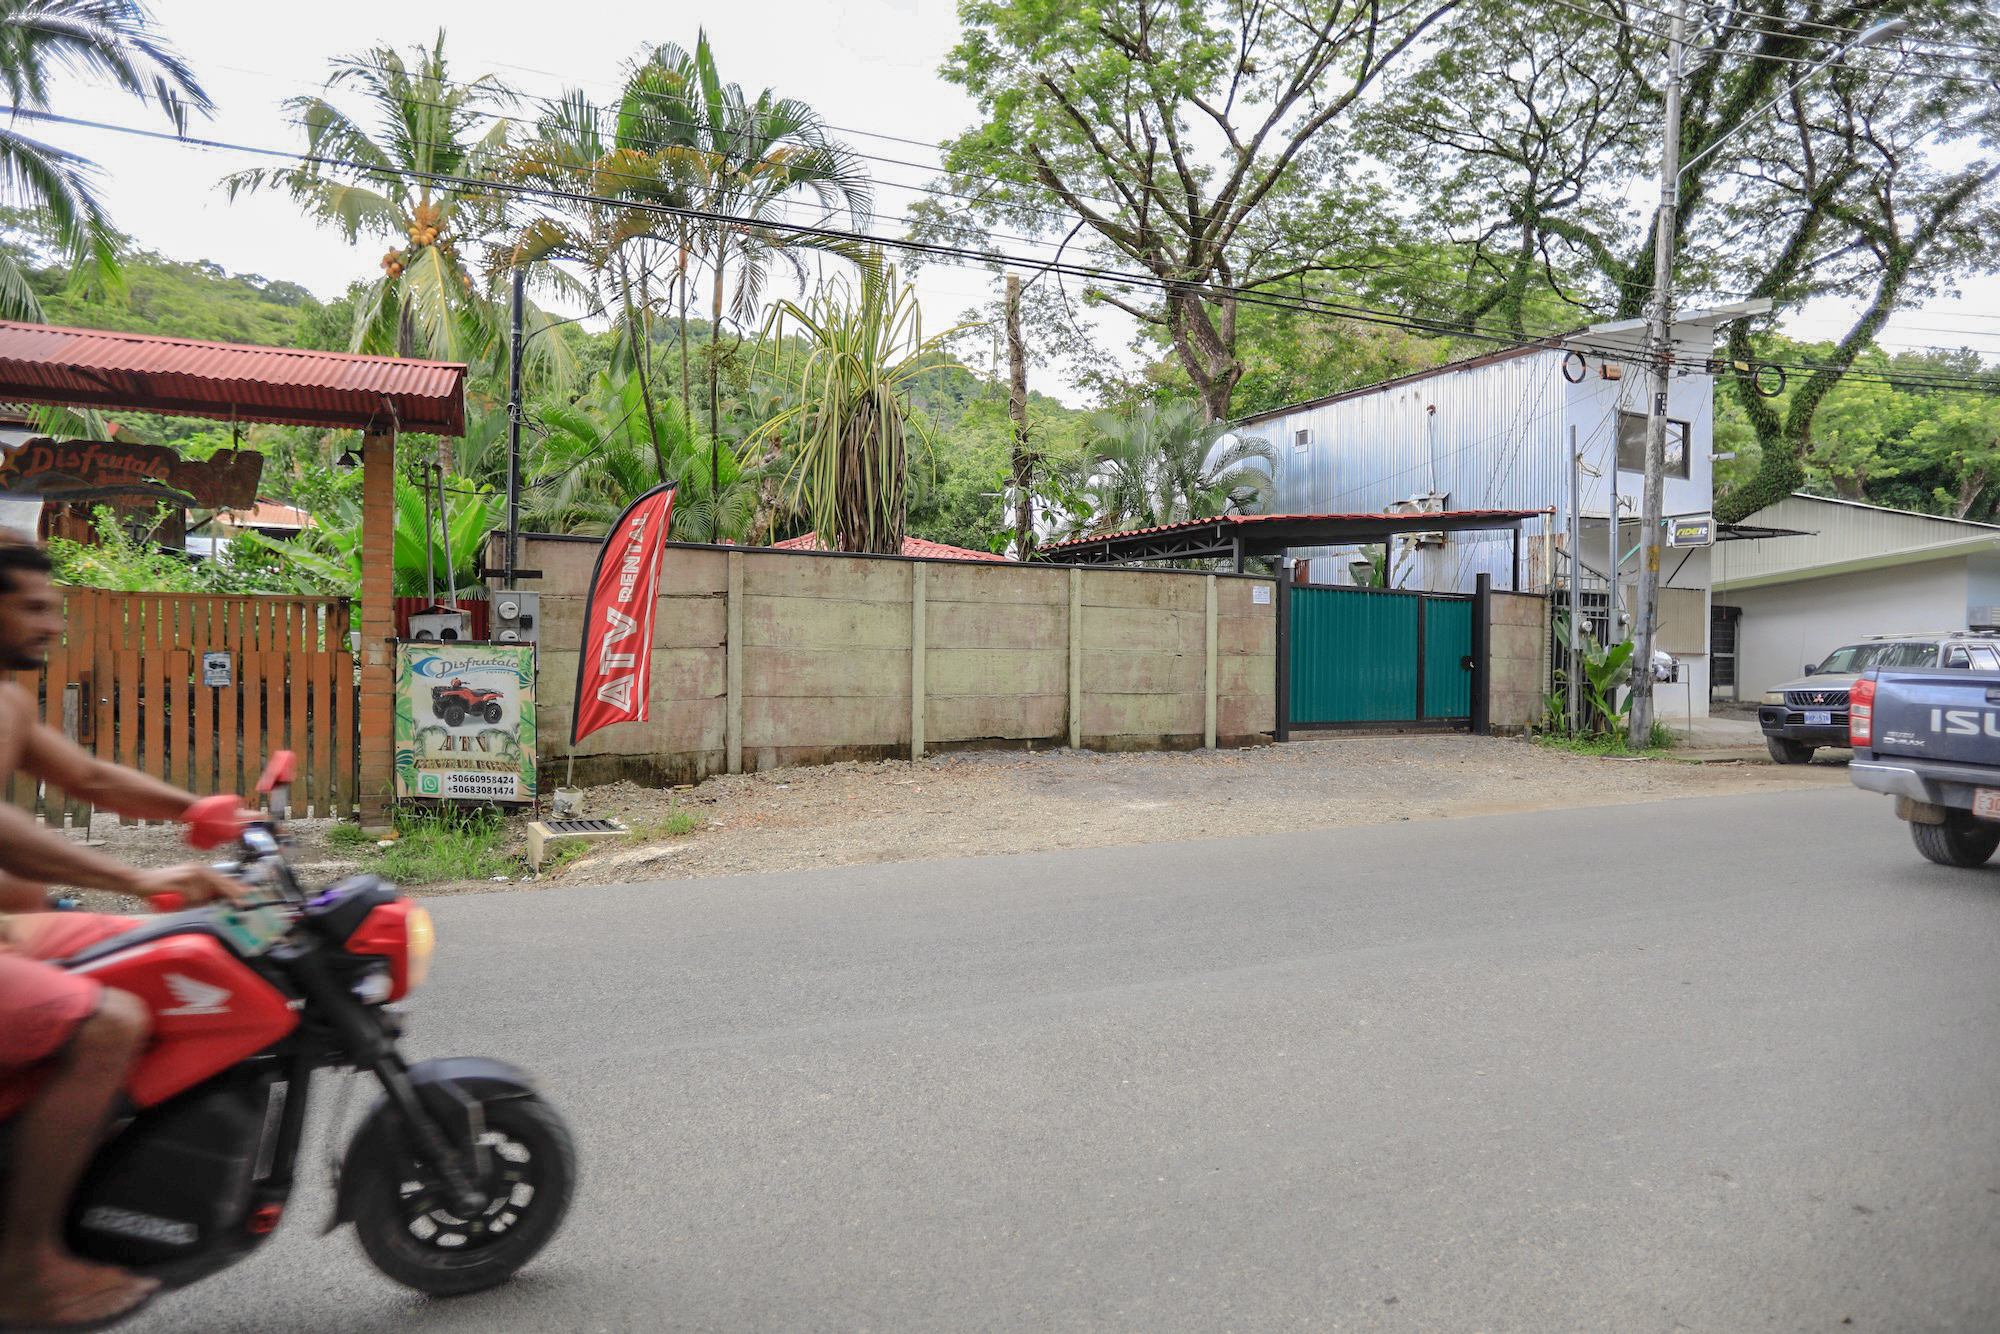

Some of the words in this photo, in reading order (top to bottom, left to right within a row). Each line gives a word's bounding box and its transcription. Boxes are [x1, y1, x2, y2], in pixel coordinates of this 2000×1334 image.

[597, 606, 638, 714] ATV
[618, 512, 649, 603] RENTAL
[435, 656, 519, 679] Disfrutalo
[439, 735, 488, 752] ATV
[447, 774, 514, 784] +50660958424
[447, 785, 514, 795] +50683081474
